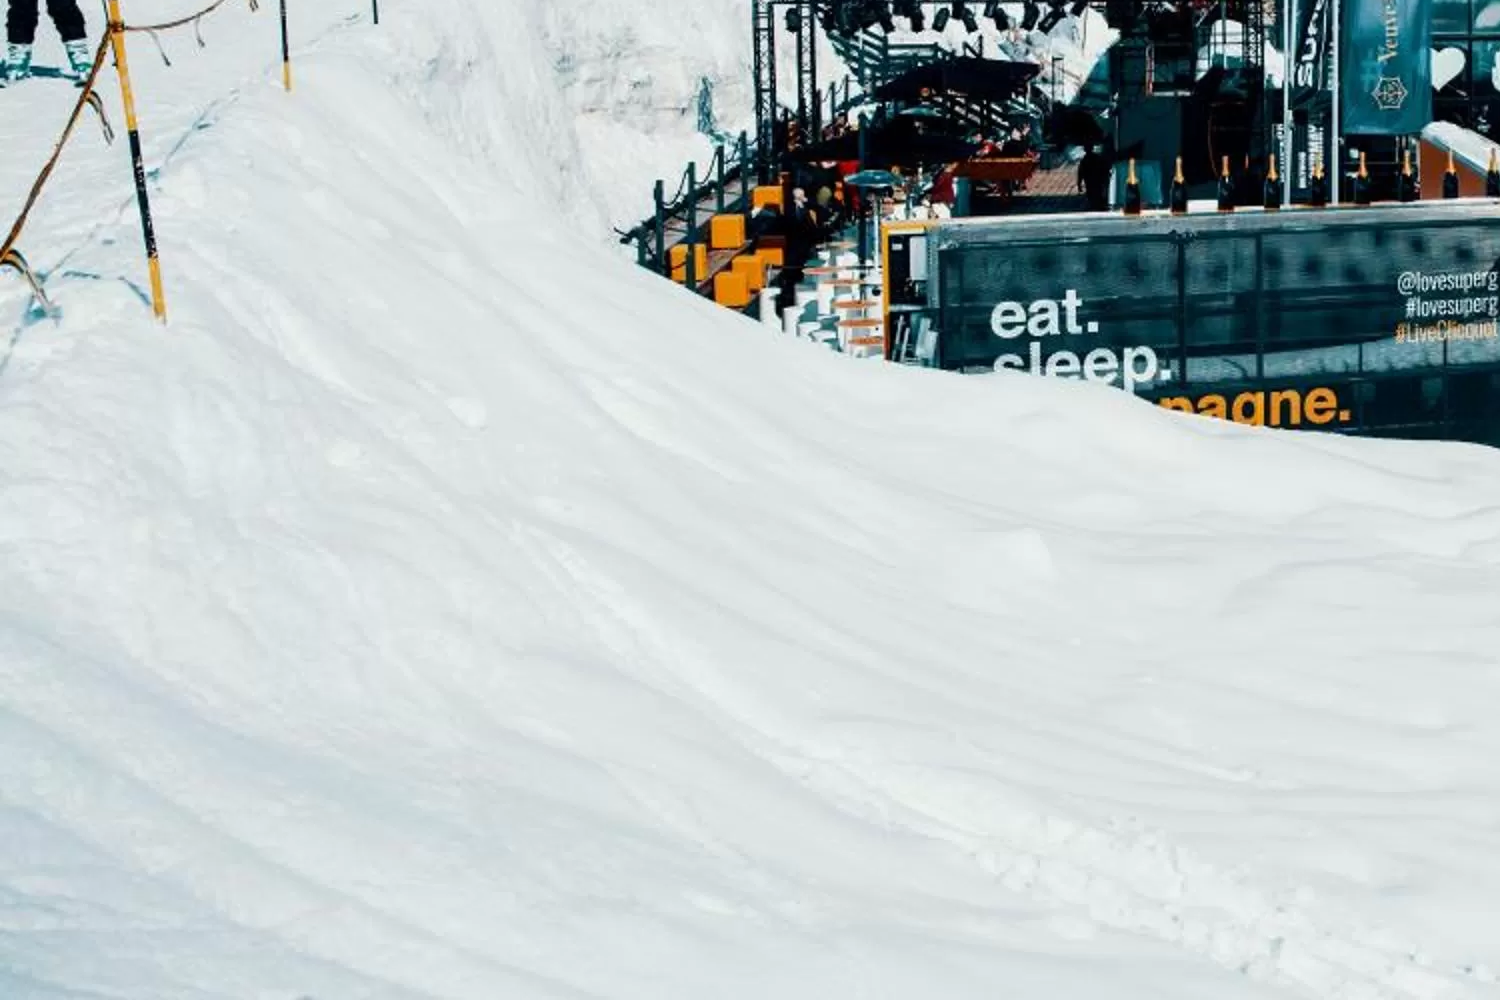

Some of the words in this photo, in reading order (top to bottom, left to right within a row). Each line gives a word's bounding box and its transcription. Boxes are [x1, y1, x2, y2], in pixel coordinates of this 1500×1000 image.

[1397, 271, 1499, 295] @lovesuperg
[990, 289, 1099, 338] eat.
[1405, 296, 1499, 318] #lovesuperg
[1394, 318, 1498, 343] #LiveClicquot
[1158, 386, 1351, 427] agne.
